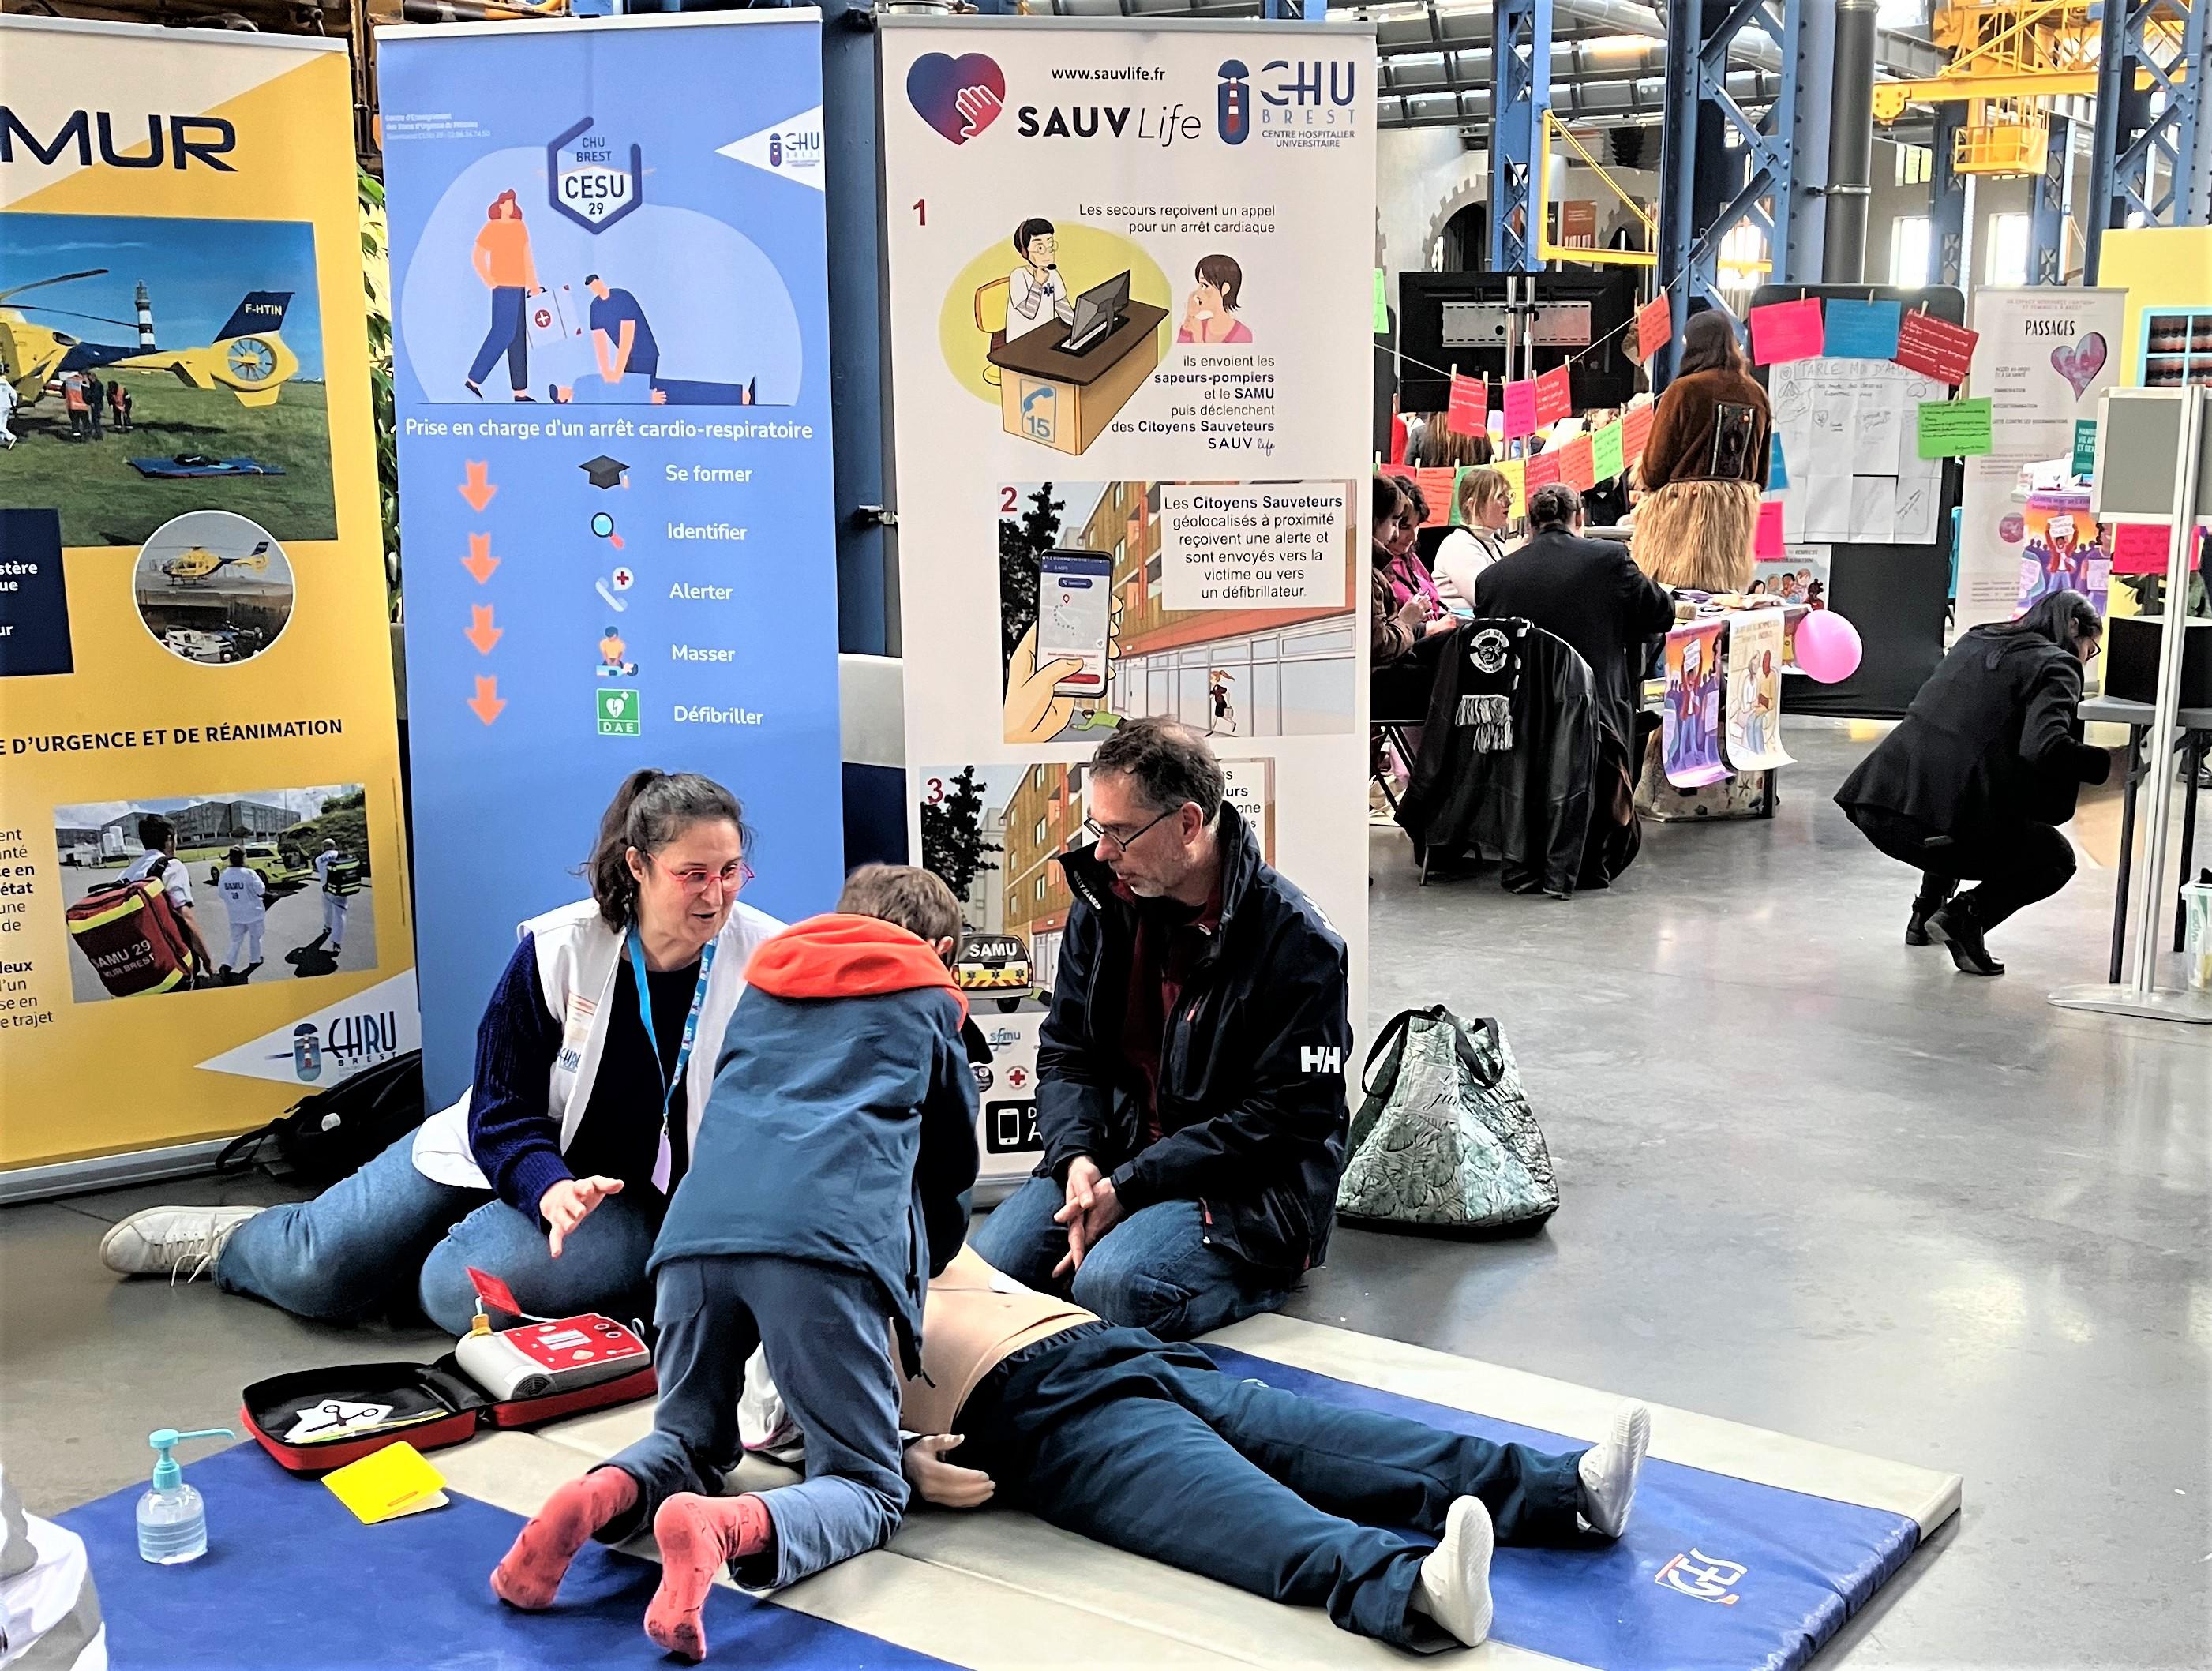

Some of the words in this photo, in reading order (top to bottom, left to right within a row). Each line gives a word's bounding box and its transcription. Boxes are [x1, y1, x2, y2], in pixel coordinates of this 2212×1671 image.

[1052, 67, 1166, 81] www.sauvlife.fr
[1262, 108, 1355, 125] BREST
[1018, 105, 1130, 138] SAUV
[1138, 103, 1202, 147] Life
[1262, 130, 1296, 139] CENTRE
[1298, 129, 1355, 139] HOSPITALIER
[581, 137, 605, 148] CHU
[1276, 139, 1340, 148] UNIVERSITAIRE
[575, 151, 612, 163] BREST
[564, 174, 624, 200] CESU
[588, 202, 605, 215] 29
[913, 199, 927, 226] 1
[1079, 204, 1103, 216] Les
[1107, 207, 1156, 216] secours
[1160, 204, 1218, 219] reçoivent
[1221, 207, 1237, 216] un
[1240, 204, 1276, 219] appel
[1128, 223, 1157, 236] pour
[1161, 223, 1177, 233] un
[1180, 220, 1210, 233] arrêt
[1213, 220, 1276, 236] cardiaque
[244, 303, 283, 317] F-HTIN
[2025, 320, 2075, 336] PASSAGES
[1183, 355, 1197, 367] ils
[1200, 355, 1255, 367] envoient
[1258, 355, 1275, 367] les
[1154, 372, 1275, 386] sapeurs-pompiers
[1204, 388, 1216, 399] et
[1220, 388, 1230, 399] le
[1235, 388, 1275, 399] SAMU
[1171, 404, 1197, 419] puis
[1200, 404, 1275, 416] déclenchent
[406, 418, 448, 436] Prise
[452, 422, 474, 436] en
[479, 418, 540, 440] charge
[545, 419, 585, 437] d'un
[590, 418, 634, 437] arrêt
[639, 420, 813, 440] cardio-respiratoire
[1026, 415, 1051, 439] 15
[1111, 421, 1134, 433] des
[1138, 421, 1197, 435] Citoyens
[1201, 420, 1275, 433] Sauveteurs
[1208, 438, 1252, 449] SAUV
[665, 464, 688, 481] Se
[693, 464, 752, 482] former
[1001, 486, 1018, 512] 2
[1164, 496, 1189, 509] Les
[1194, 496, 1258, 513] Citoyens
[1262, 496, 1343, 509] Sauveteurs
[1172, 513, 1258, 530] géolocalisés
[1261, 514, 1270, 526] à
[1273, 512, 1335, 530] proximité
[667, 523, 748, 541] Identifier
[1179, 532, 1242, 548] reçoivent
[1245, 534, 1270, 544] une
[1274, 531, 1312, 544] alerte
[1316, 531, 1329, 543] et
[1185, 551, 1214, 563] sont
[1218, 550, 1275, 566] envoyés
[1279, 552, 1307, 562] vers
[1310, 549, 1323, 561] la
[1204, 568, 1252, 580] victime
[1255, 570, 1273, 580] ou
[1276, 570, 1305, 579] vers
[669, 583, 733, 601] Alerter
[1201, 588, 1218, 599] un
[1222, 585, 1307, 599] défibrillateur.
[672, 644, 736, 663] Masser
[673, 706, 764, 726] Défibriller
[13, 732, 137, 755] D'URGENCE
[143, 729, 167, 747] ET
[174, 727, 200, 744] DE
[208, 717, 343, 742] RÉANIMATION
[928, 777, 944, 805] 3
[16, 865, 35, 876] en
[2, 918, 21, 932] de
[91, 948, 129, 969] SAMU
[131, 939, 152, 956] 29
[969, 941, 1018, 957] SAMU
[0, 961, 33, 974] eux
[19, 997, 37, 1008] en
[13, 1011, 54, 1028] trajet
[321, 1011, 397, 1059] CHRU
[338, 1051, 397, 1066] BREST
[1301, 1046, 1341, 1073] HH
